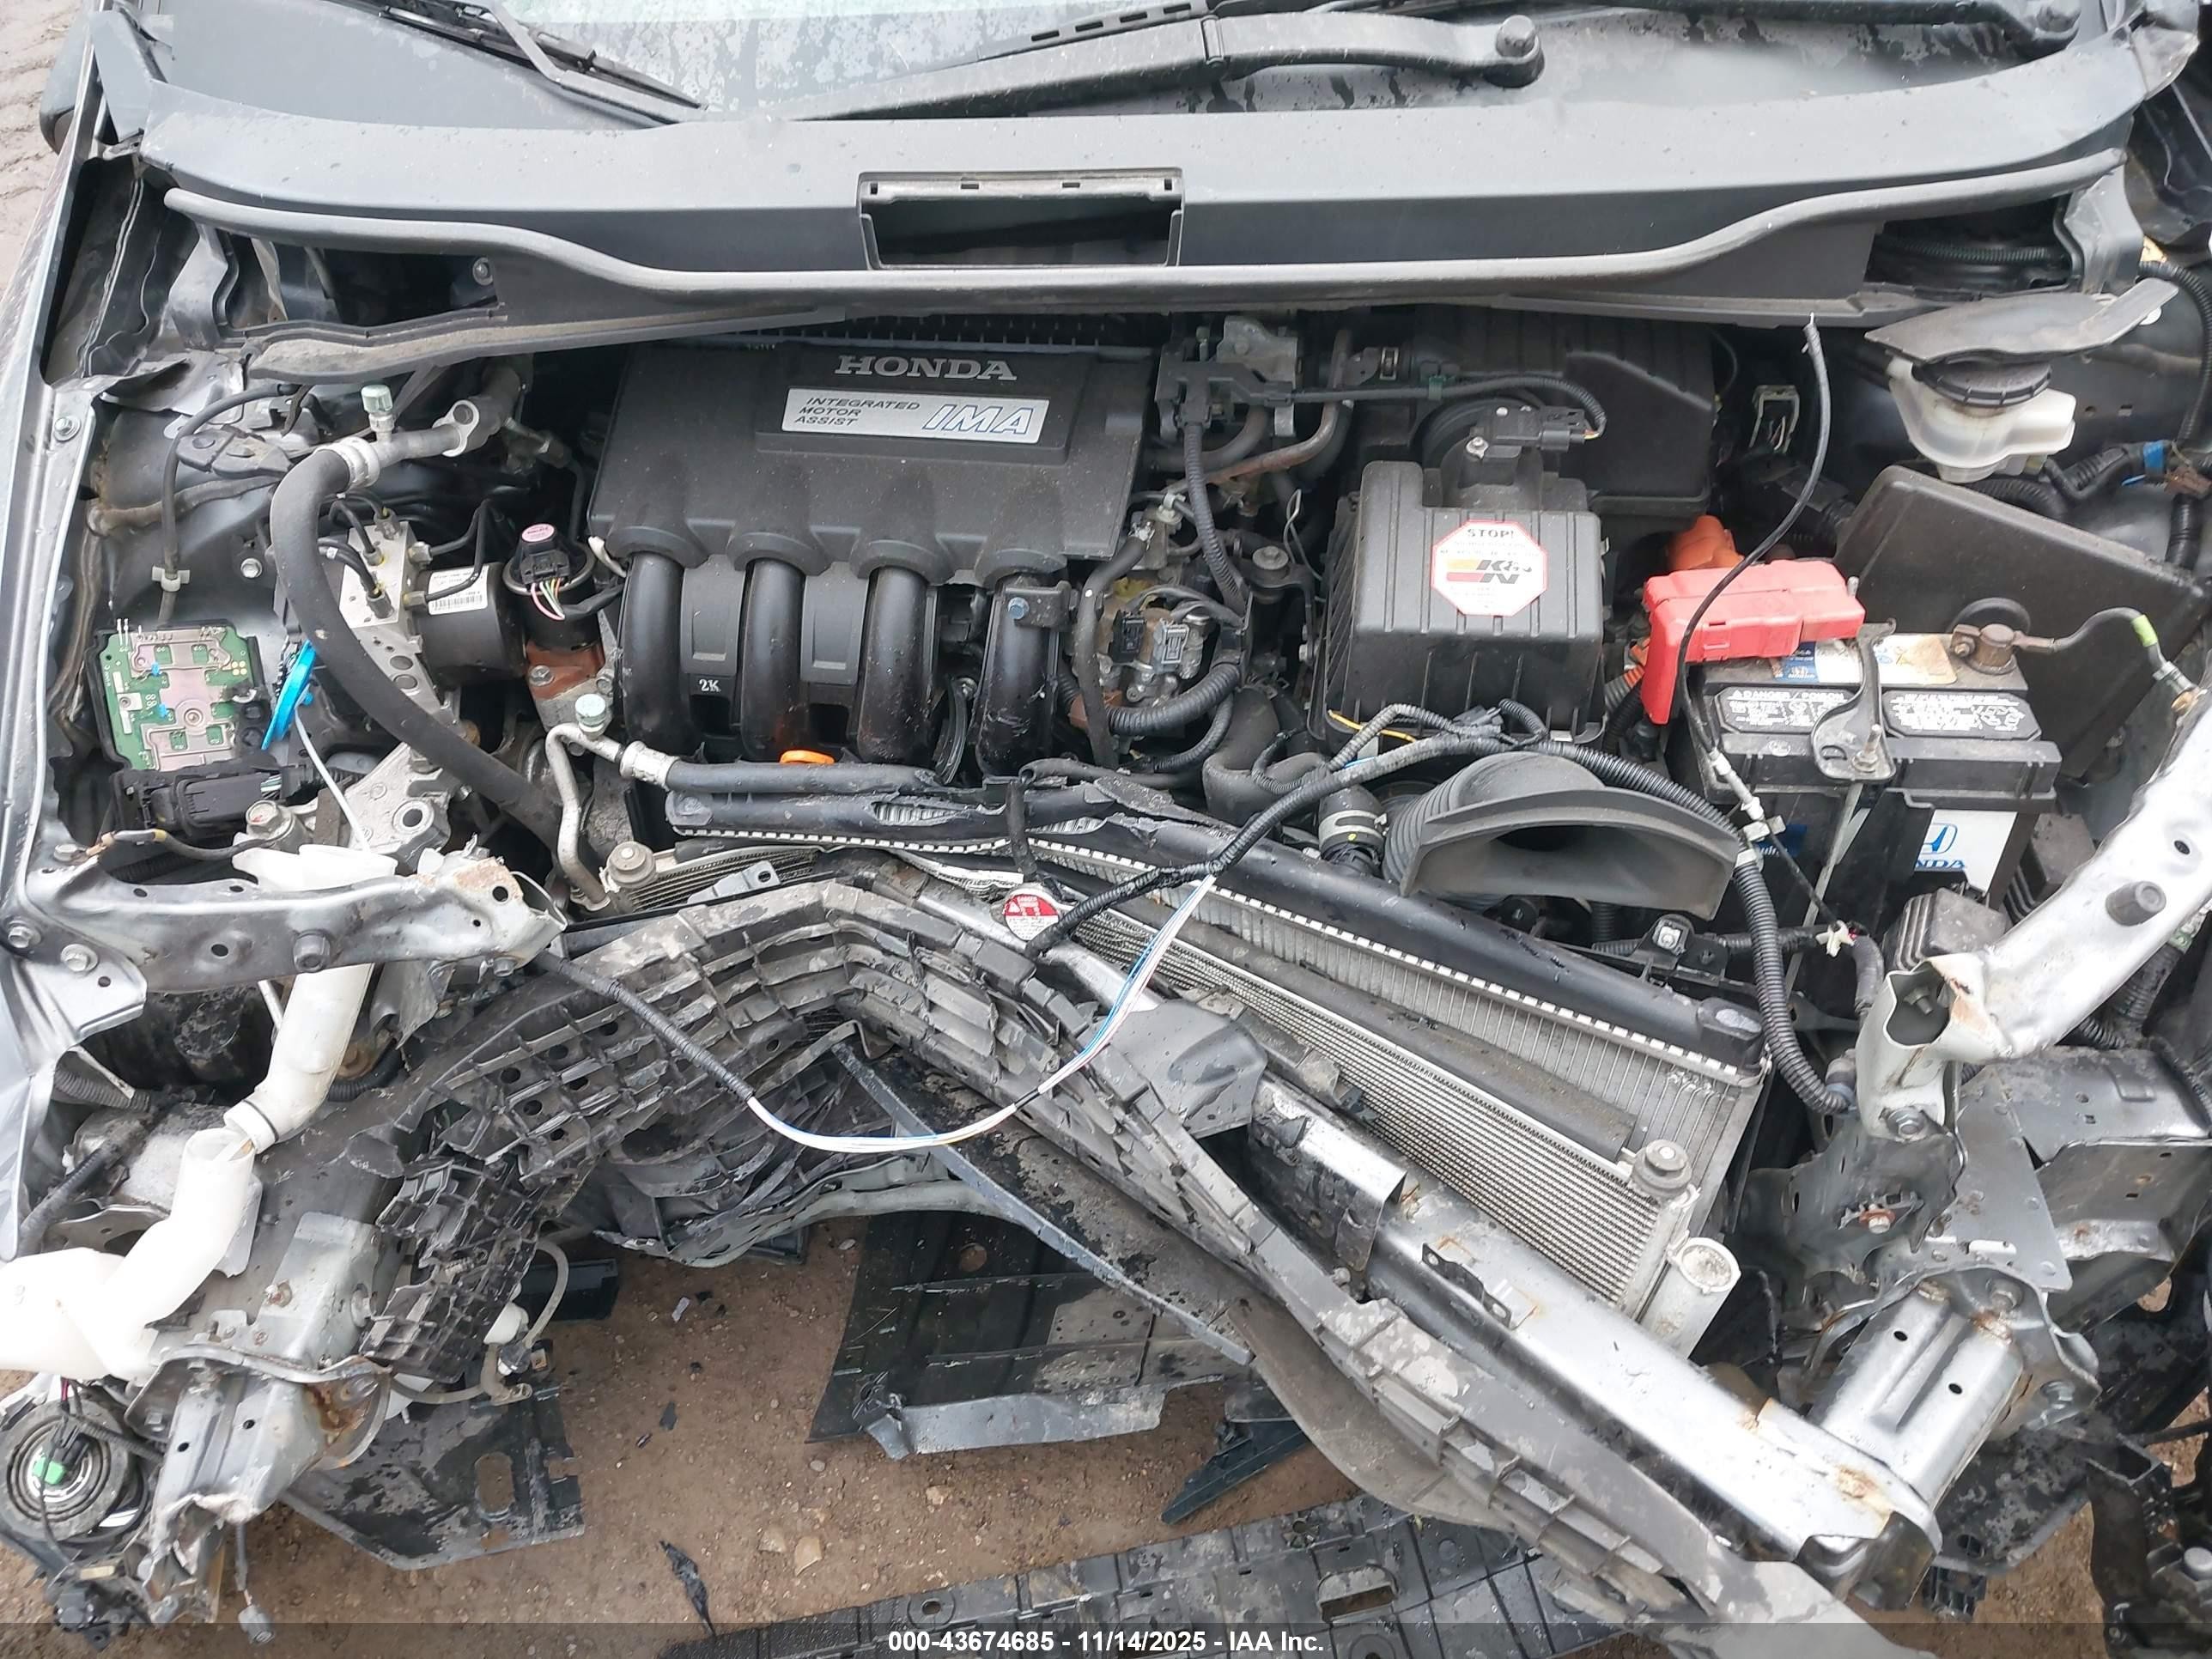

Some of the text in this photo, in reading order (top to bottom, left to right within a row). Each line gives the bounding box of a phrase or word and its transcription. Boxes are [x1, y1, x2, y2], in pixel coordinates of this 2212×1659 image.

[835, 355, 1018, 380] HONDA
[805, 397, 921, 410] INTEGRATED
[799, 407, 861, 416] MOTOR
[794, 416, 859, 426] ASSIST
[921, 404, 1034, 434] IMA
[1468, 529, 1515, 538] STOP!
